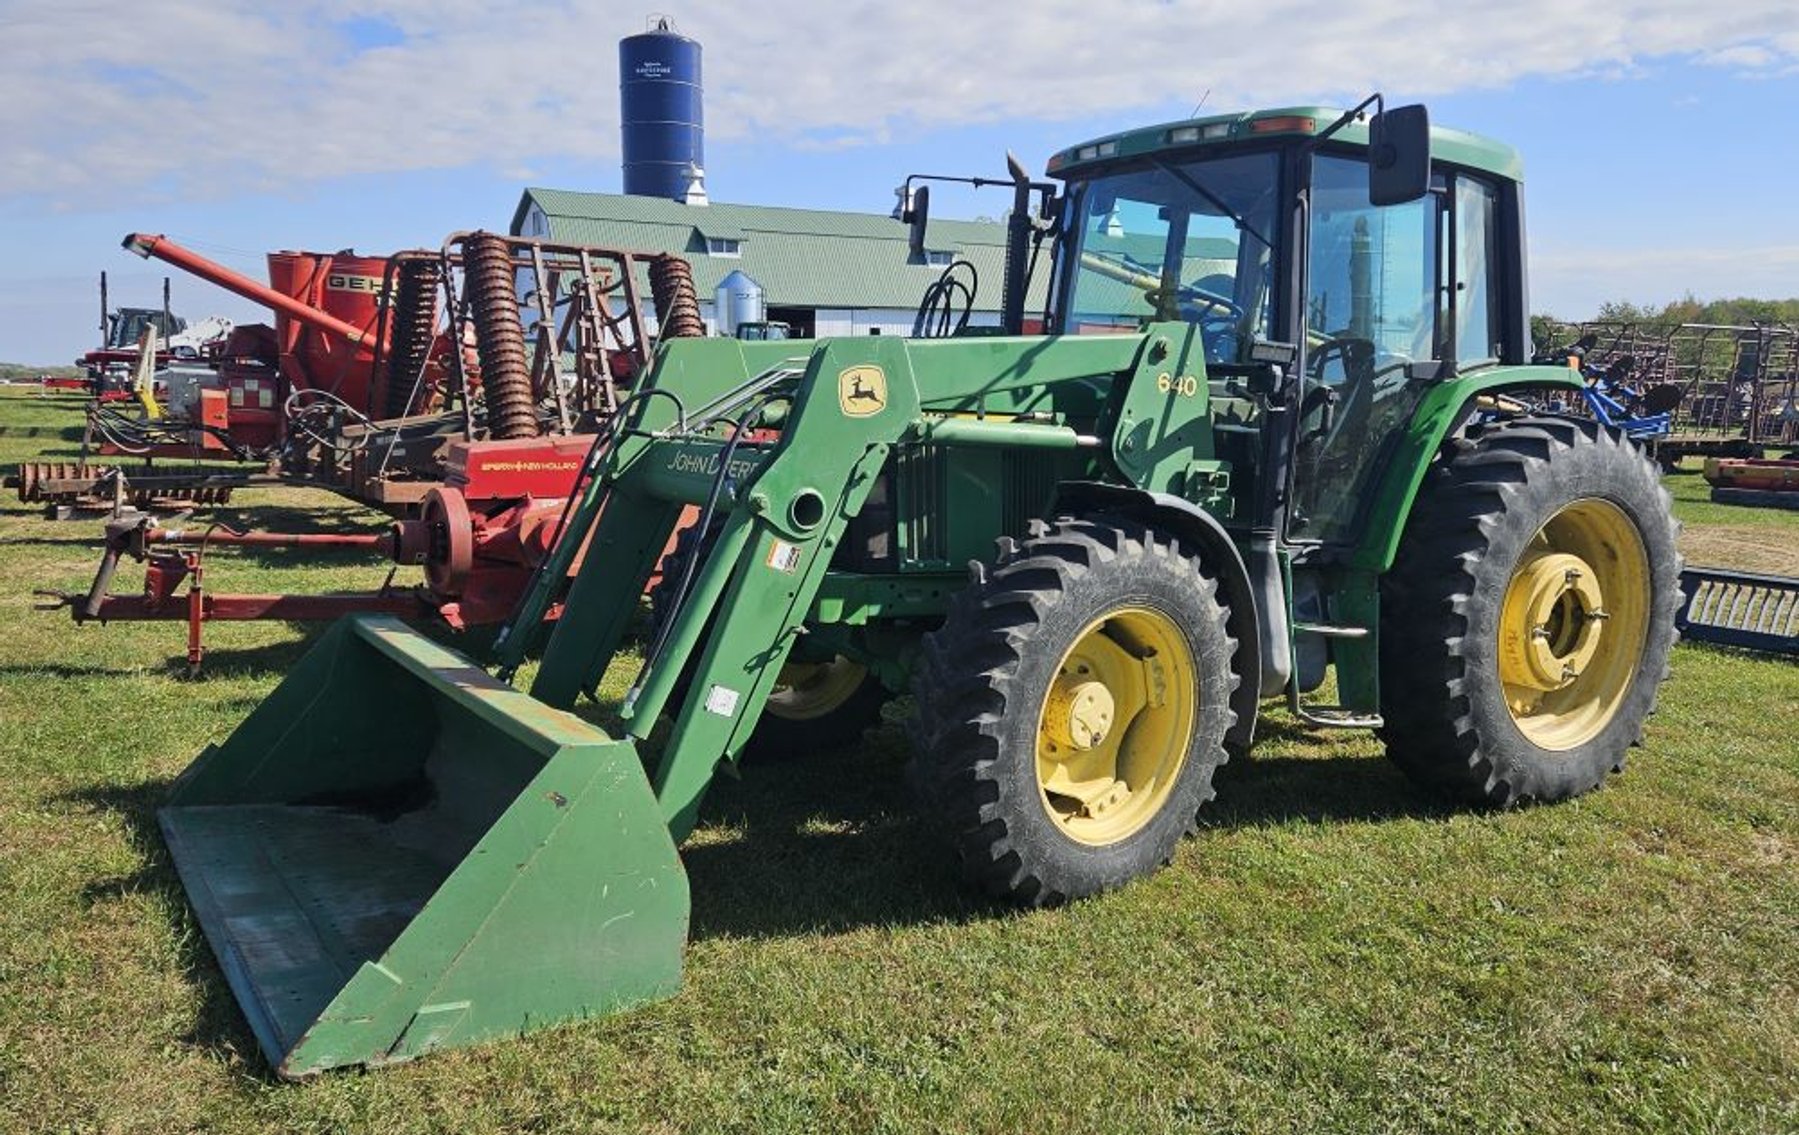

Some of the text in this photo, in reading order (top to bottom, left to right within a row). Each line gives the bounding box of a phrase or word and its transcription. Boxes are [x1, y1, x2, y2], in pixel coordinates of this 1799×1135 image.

[329, 274, 393, 291] GEH
[1158, 372, 1197, 397] 640
[666, 449, 760, 478] JOHN DER
